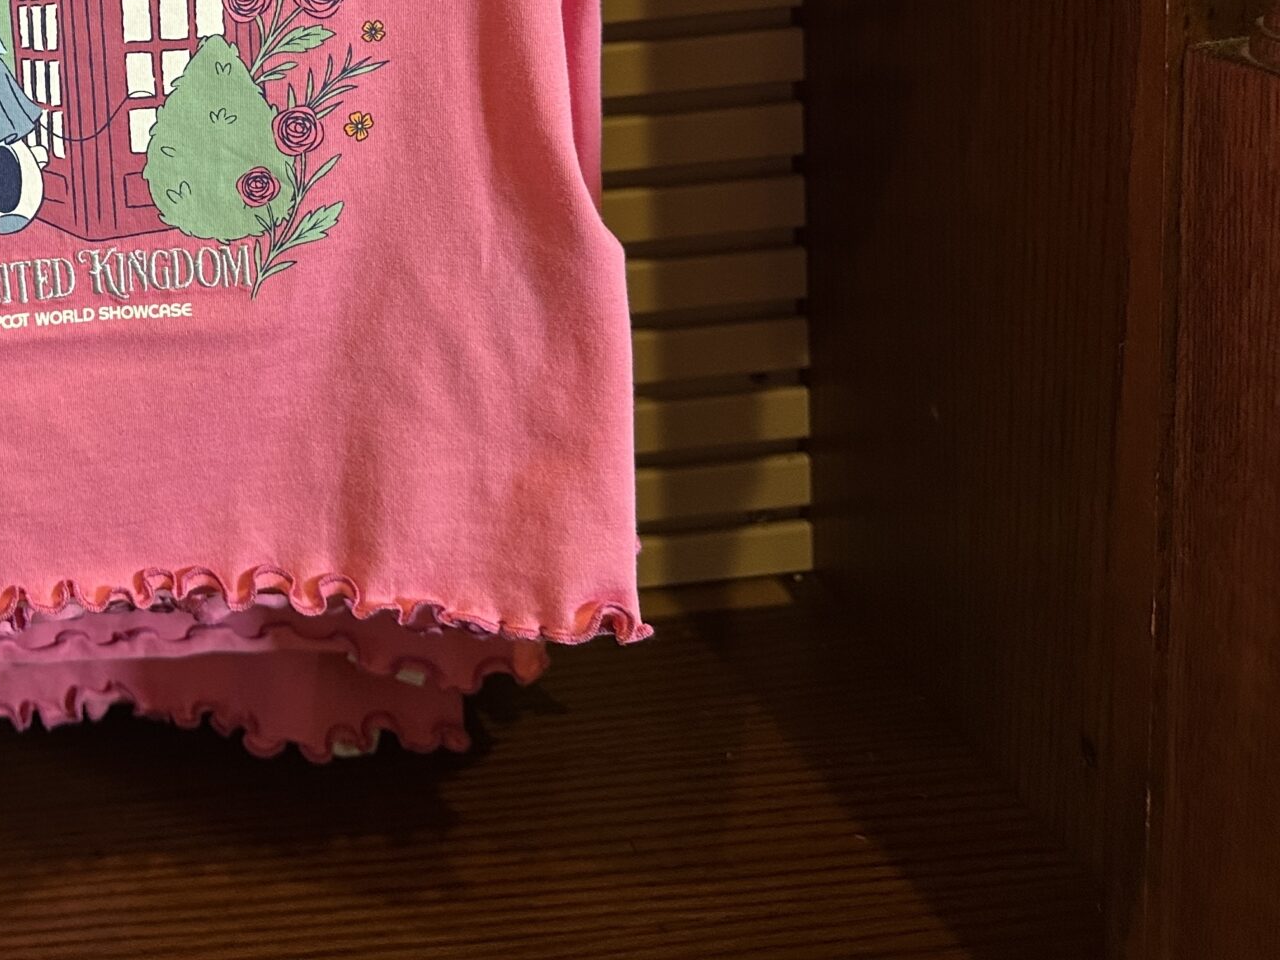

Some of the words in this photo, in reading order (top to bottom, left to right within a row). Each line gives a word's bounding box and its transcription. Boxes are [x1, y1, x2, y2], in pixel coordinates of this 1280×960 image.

[77, 244, 253, 300] KINGDOM
[35, 308, 95, 327] WORLD
[99, 303, 193, 322] SHOWCASE
